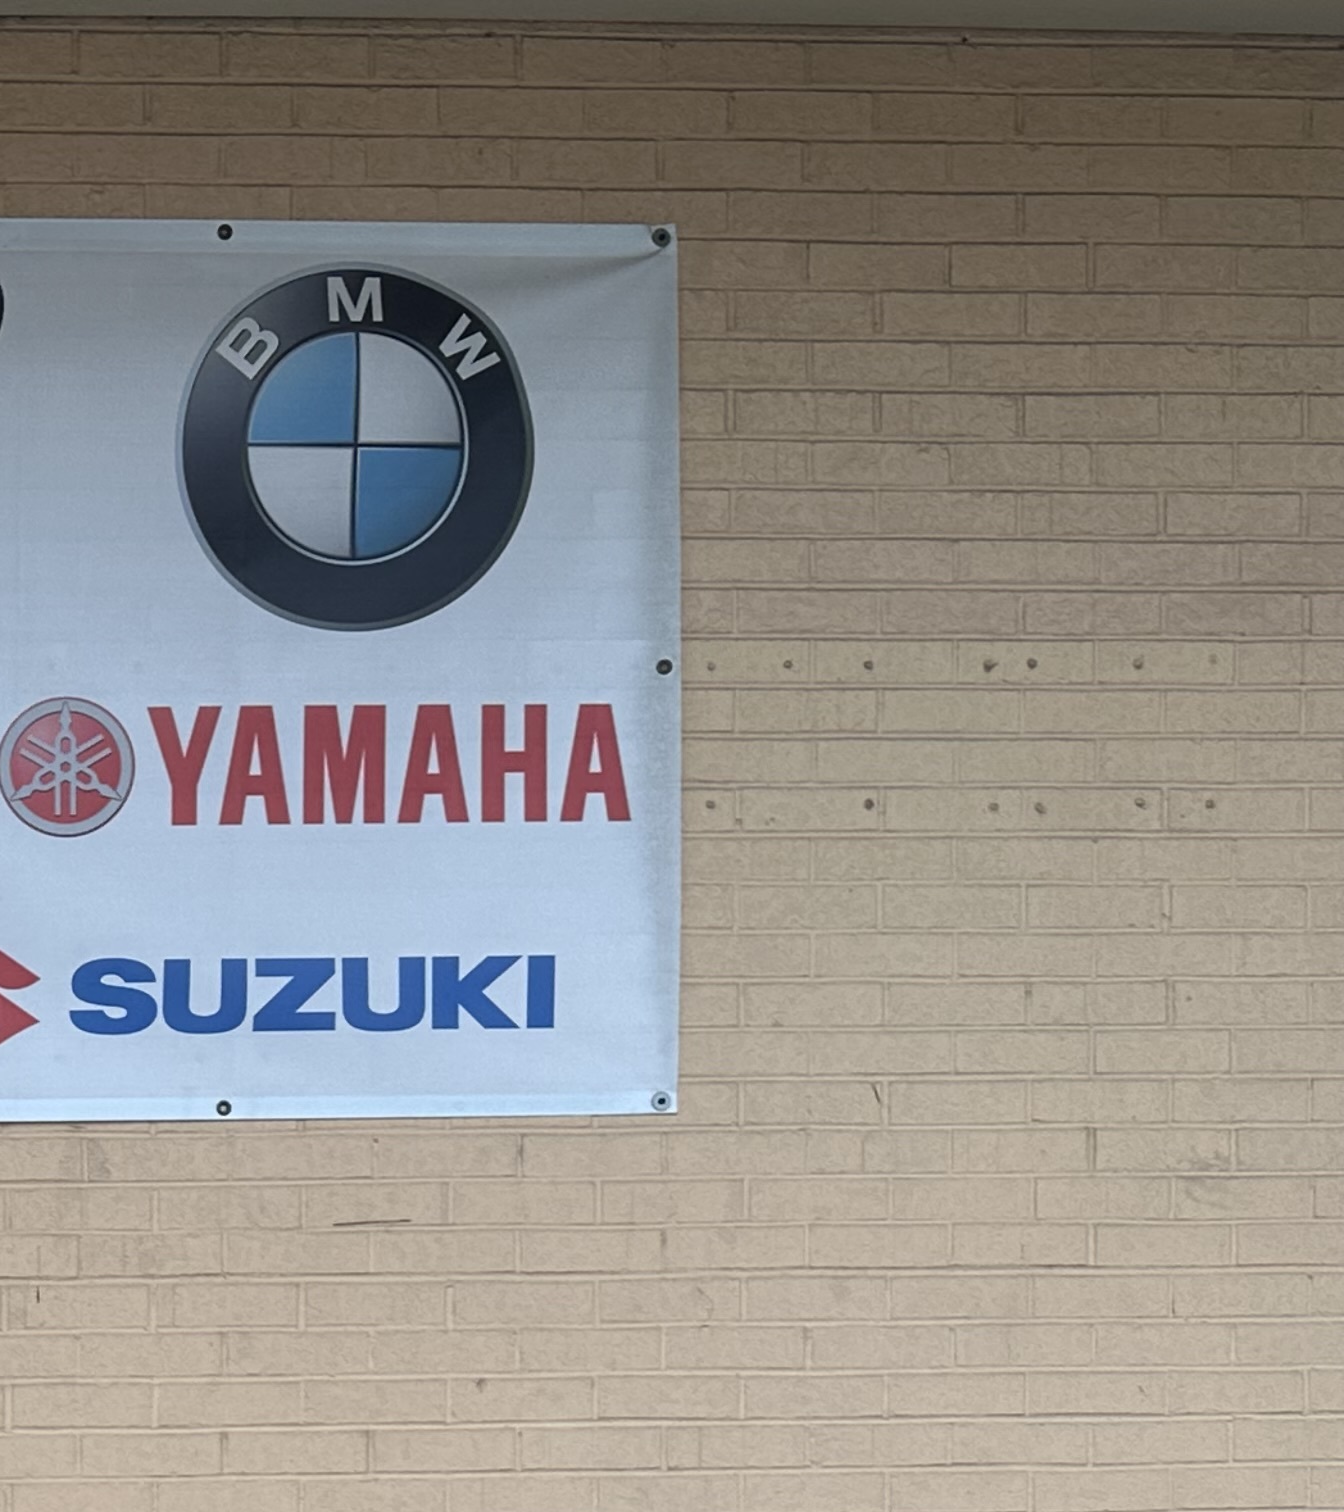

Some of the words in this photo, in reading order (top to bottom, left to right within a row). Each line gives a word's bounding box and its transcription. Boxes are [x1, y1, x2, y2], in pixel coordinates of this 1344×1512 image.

[215, 276, 501, 381] BMW
[147, 703, 631, 825] YAMAHA
[68, 955, 556, 1036] SUZUKI
